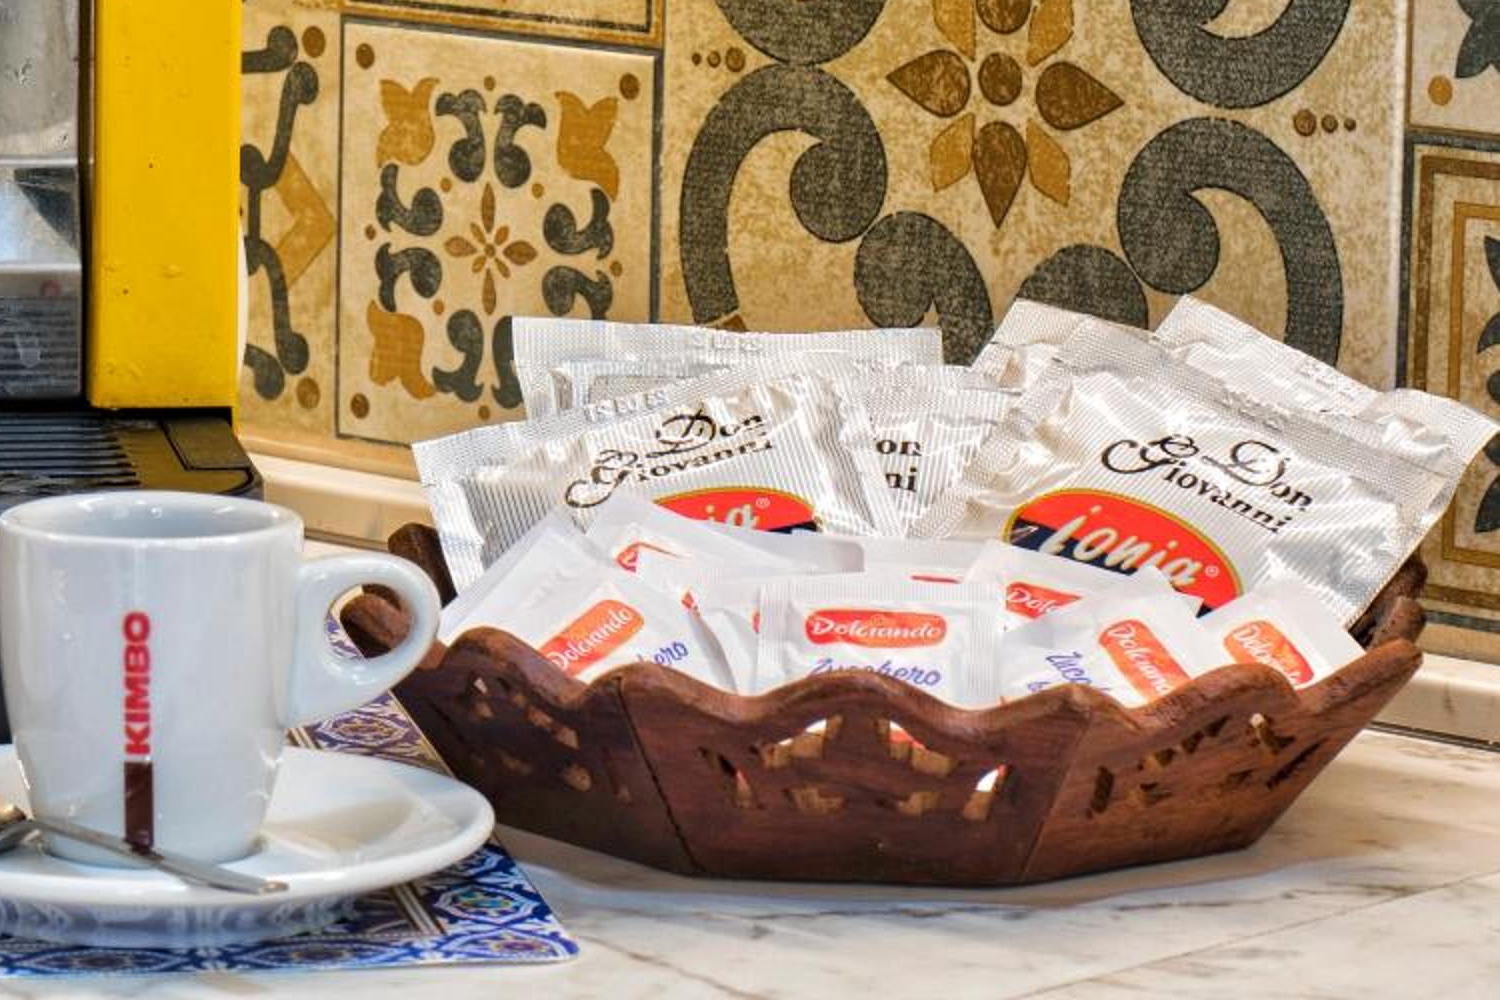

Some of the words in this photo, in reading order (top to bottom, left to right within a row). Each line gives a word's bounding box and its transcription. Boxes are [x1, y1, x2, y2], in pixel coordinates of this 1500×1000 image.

[565, 430, 774, 508] Giovanni
[646, 409, 764, 459] Don
[875, 439, 922, 457] on
[1101, 433, 1293, 534] Giovanni
[1201, 440, 1313, 511] Don
[811, 615, 942, 639] Dolciando
[122, 610, 152, 756] KIMBO
